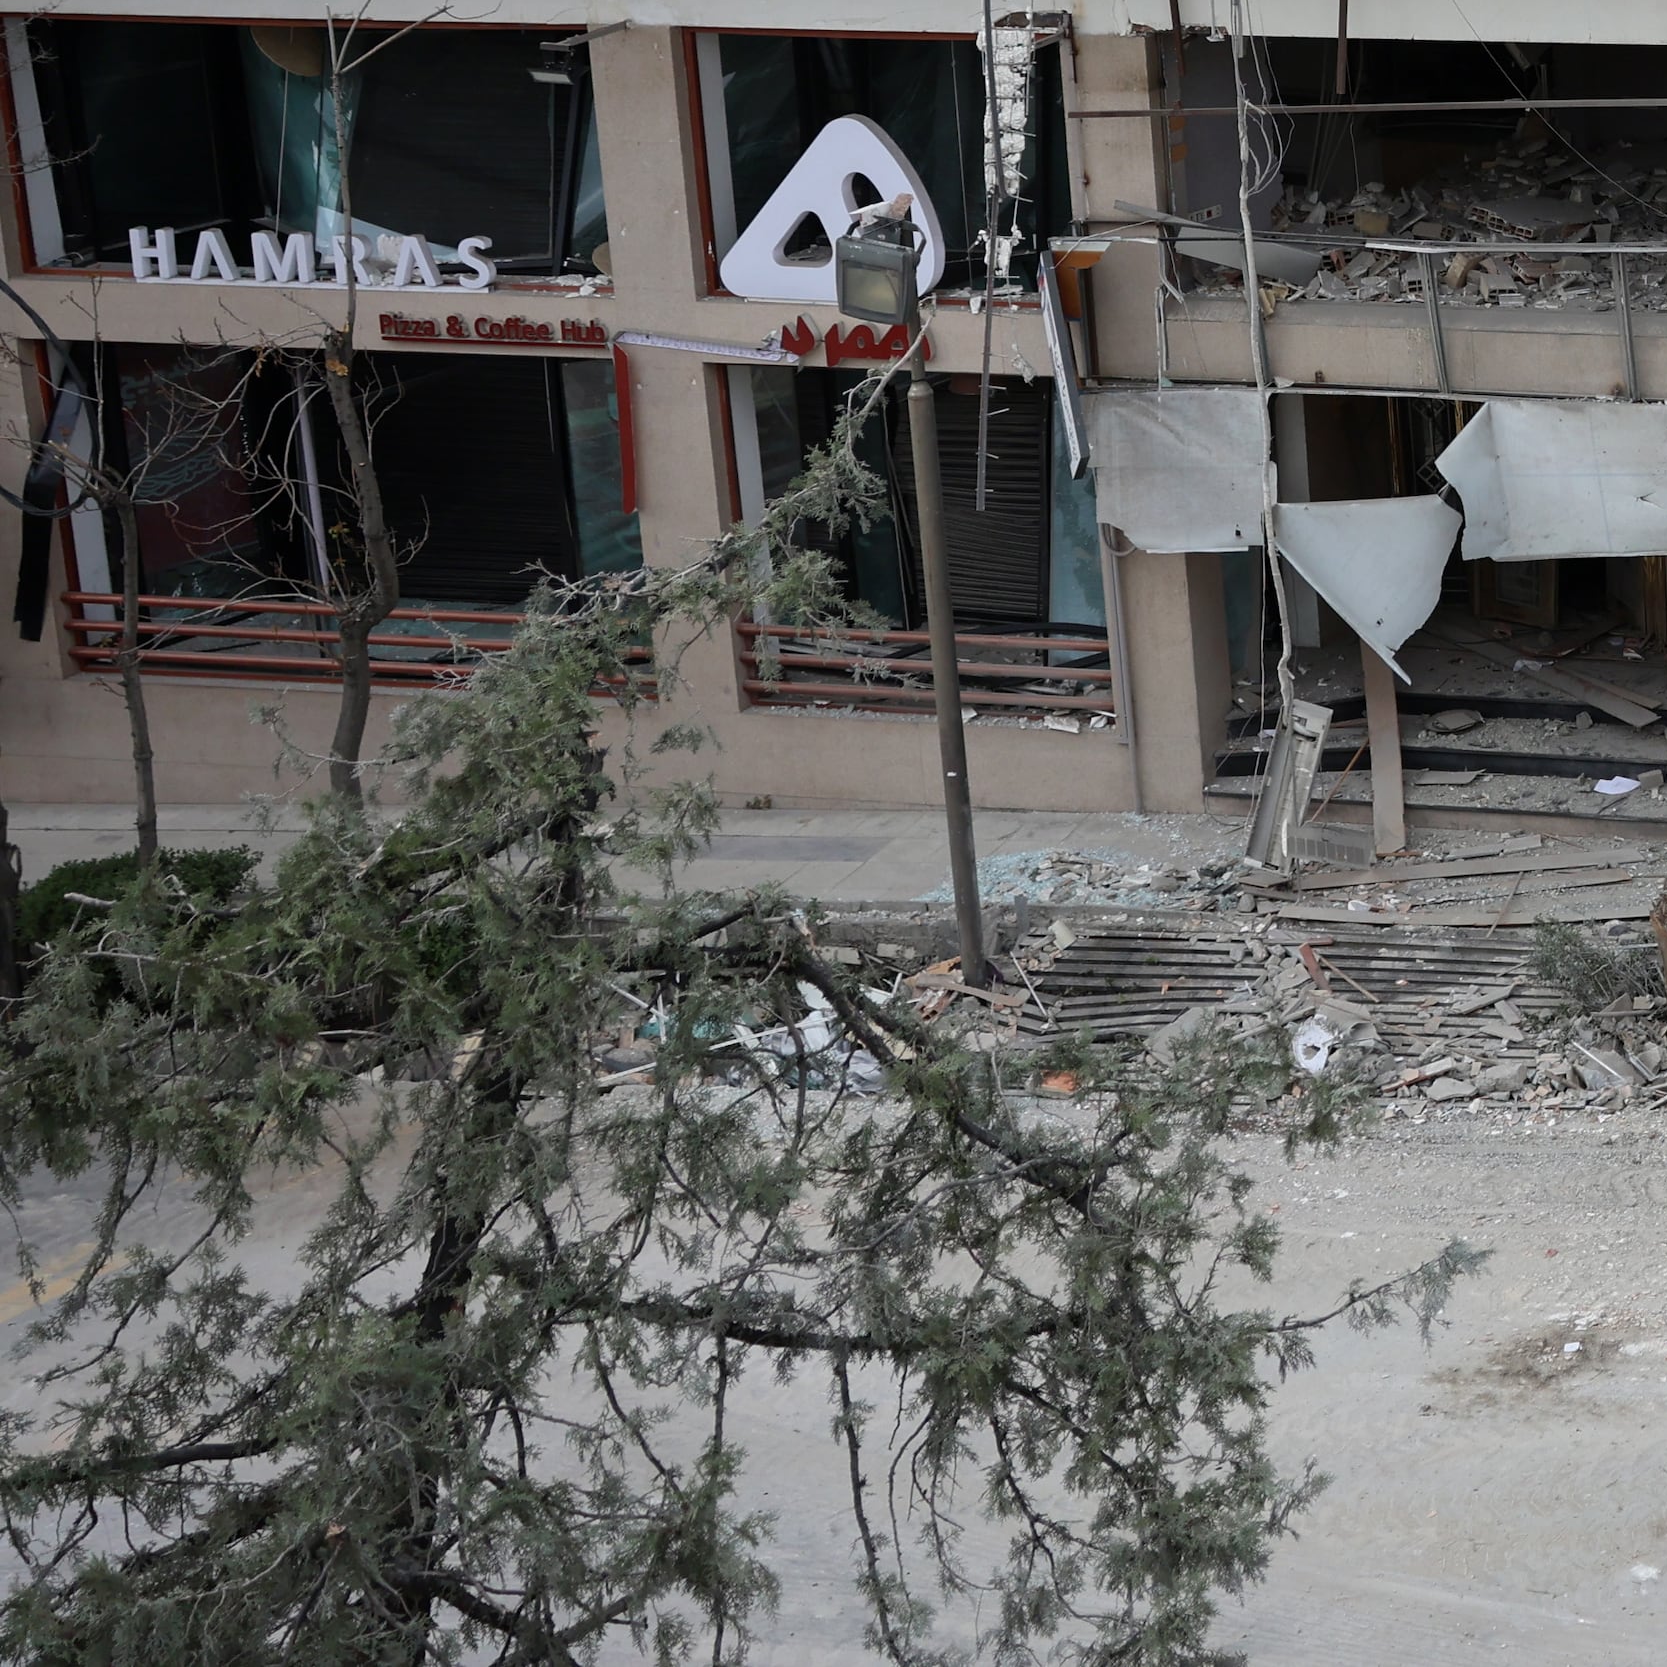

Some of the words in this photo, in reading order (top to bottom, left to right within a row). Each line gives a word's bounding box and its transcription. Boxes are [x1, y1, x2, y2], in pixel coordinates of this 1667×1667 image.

[129, 225, 497, 289] HAMRAS
[379, 312, 438, 337] Pizza
[446, 315, 467, 338] &
[474, 316, 552, 341] Coffee
[560, 319, 607, 343] Hub
